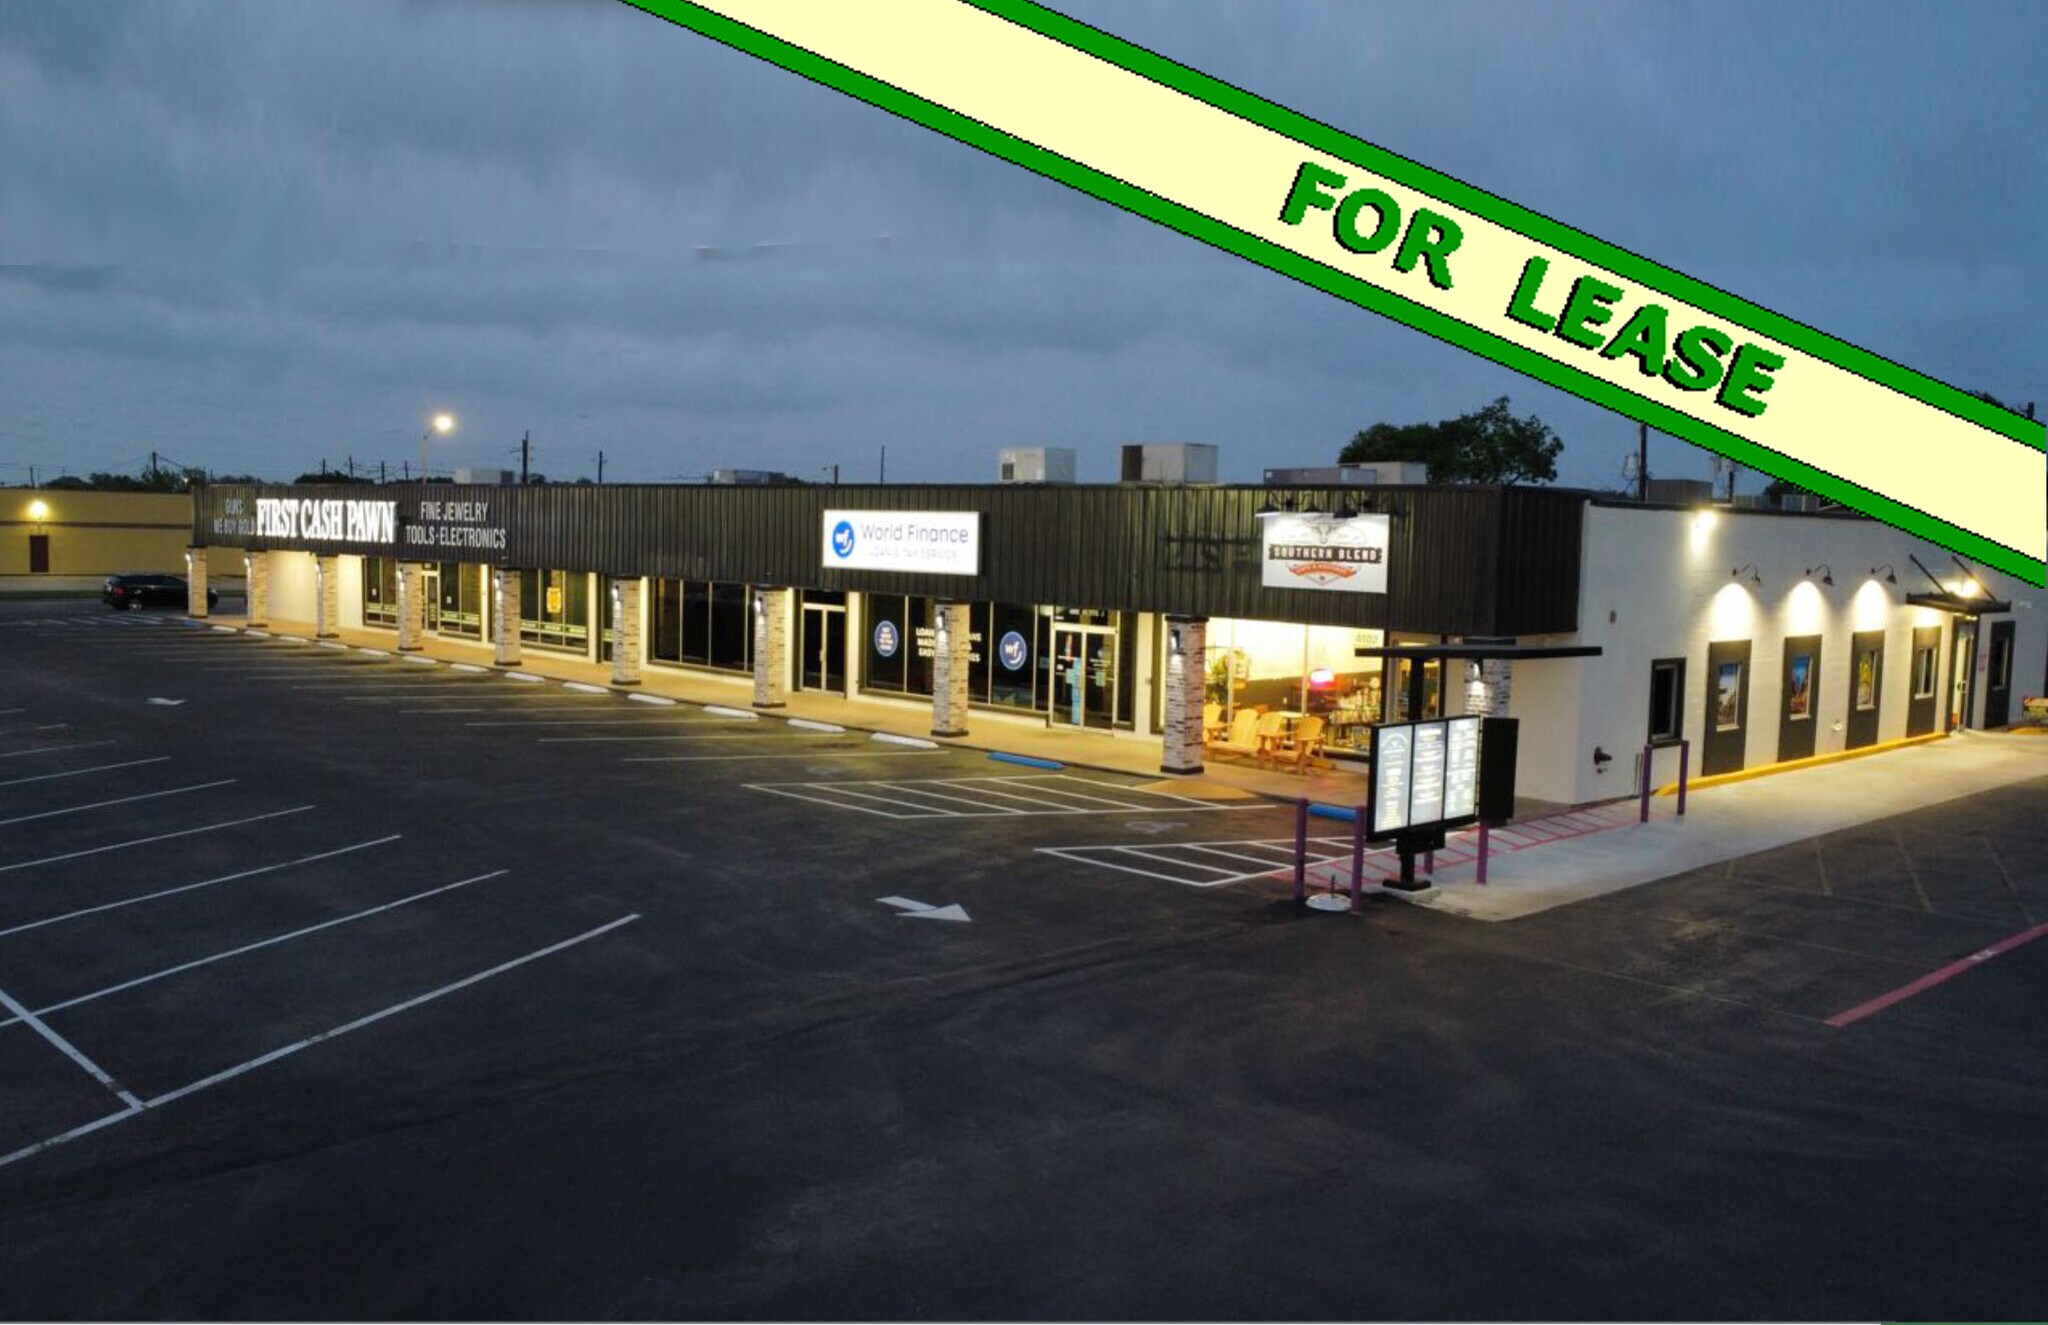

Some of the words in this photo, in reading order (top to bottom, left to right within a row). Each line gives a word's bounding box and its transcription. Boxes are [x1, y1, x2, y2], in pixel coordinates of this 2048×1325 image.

[256, 498, 300, 538] FIRST
[300, 498, 343, 541] CASH
[346, 500, 395, 543] PAWN
[421, 501, 441, 520] FINE
[443, 501, 488, 522] JEWELRY
[862, 524, 902, 542] World
[907, 525, 969, 543] Finance
[1274, 546, 1333, 560] SOUTHERN
[1338, 548, 1377, 561] BLEND
